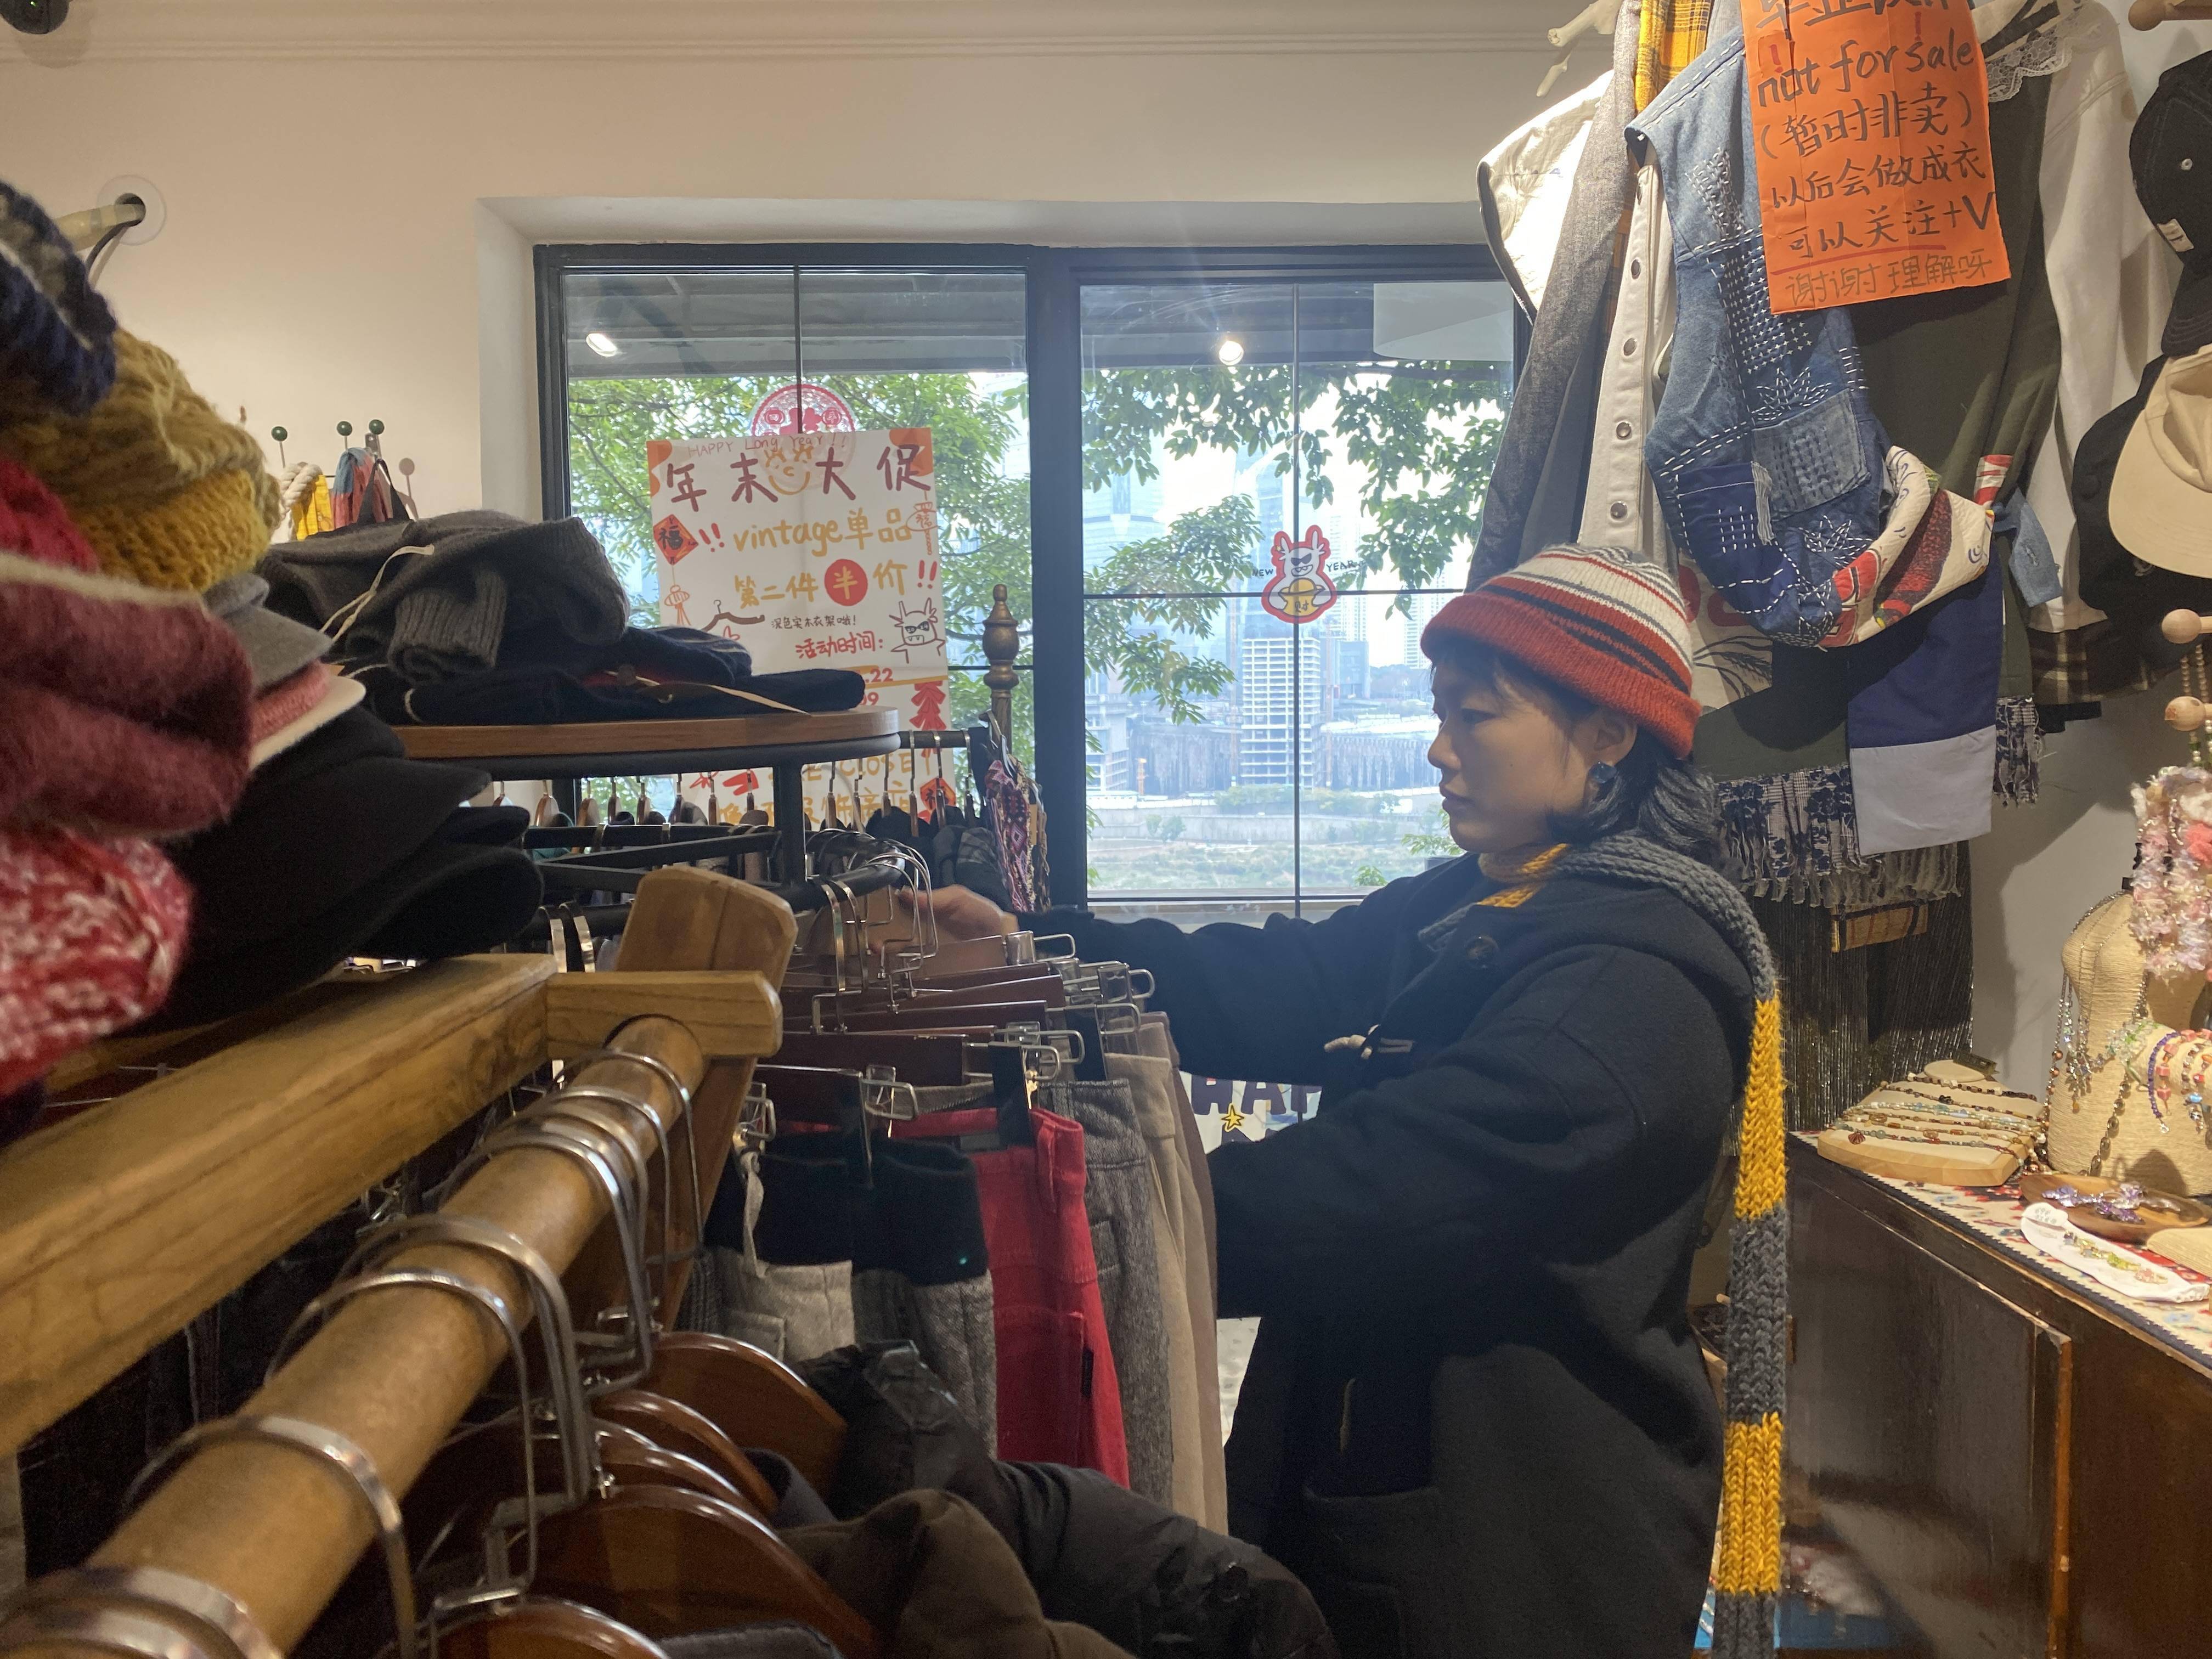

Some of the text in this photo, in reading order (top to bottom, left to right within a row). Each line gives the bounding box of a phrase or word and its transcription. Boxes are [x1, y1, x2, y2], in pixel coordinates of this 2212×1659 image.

[1757, 27, 1974, 108] not for sale
[1772, 140, 1987, 209] 以后会做成衣
[688, 441, 733, 458] HAPPY
[1252, 568, 1273, 577] NEW
